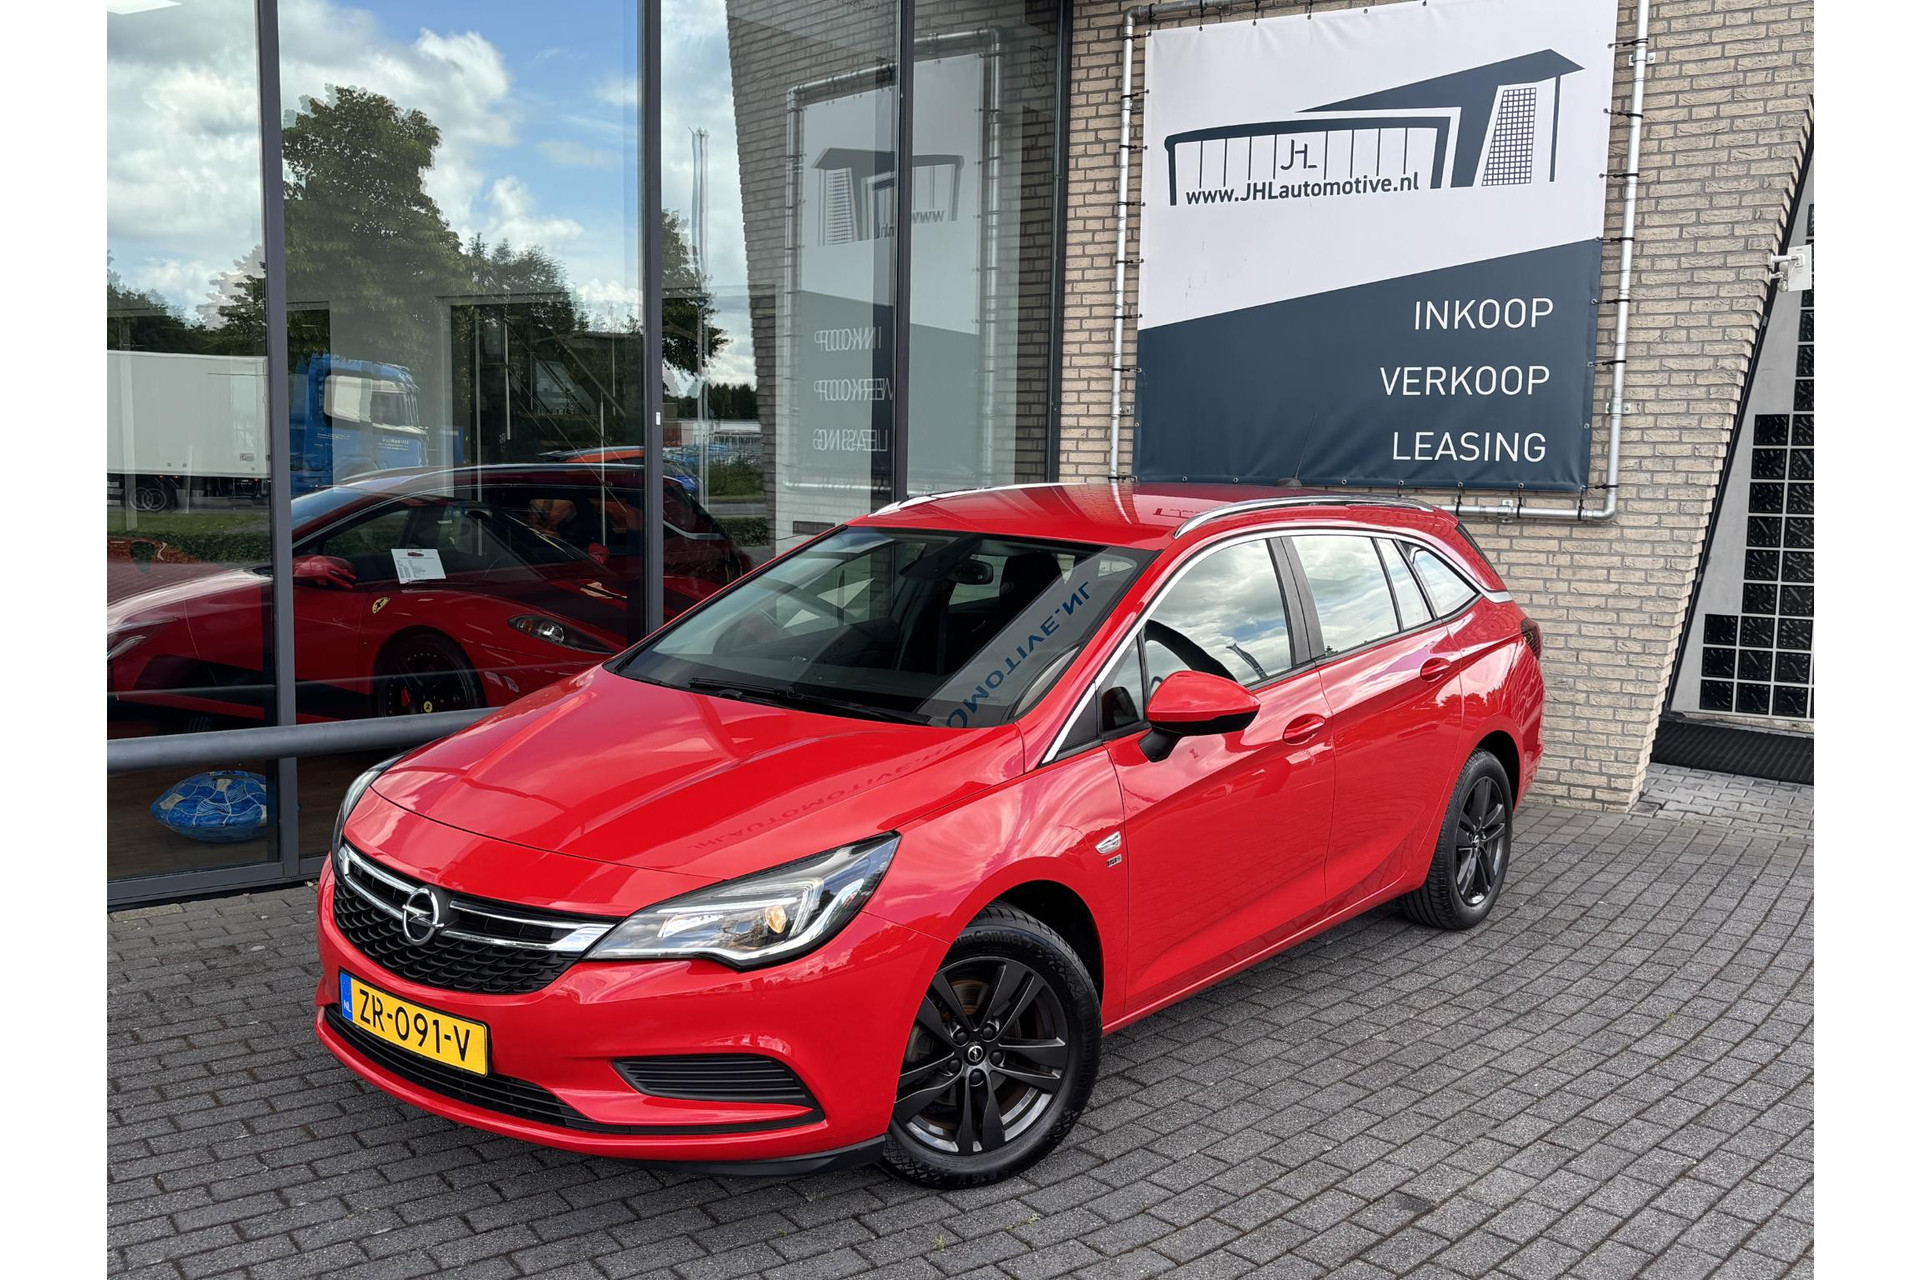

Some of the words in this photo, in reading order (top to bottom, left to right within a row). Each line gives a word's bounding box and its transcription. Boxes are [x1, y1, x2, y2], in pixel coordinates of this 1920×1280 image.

[1186, 171, 1420, 205] www.JHLautomotive.nl
[1415, 297, 1554, 330] INKOOP
[1380, 365, 1550, 396] VERKOOP
[1393, 431, 1547, 463] LEASING
[343, 999, 352, 1013] NL
[359, 988, 471, 1062] ZR-091-V
